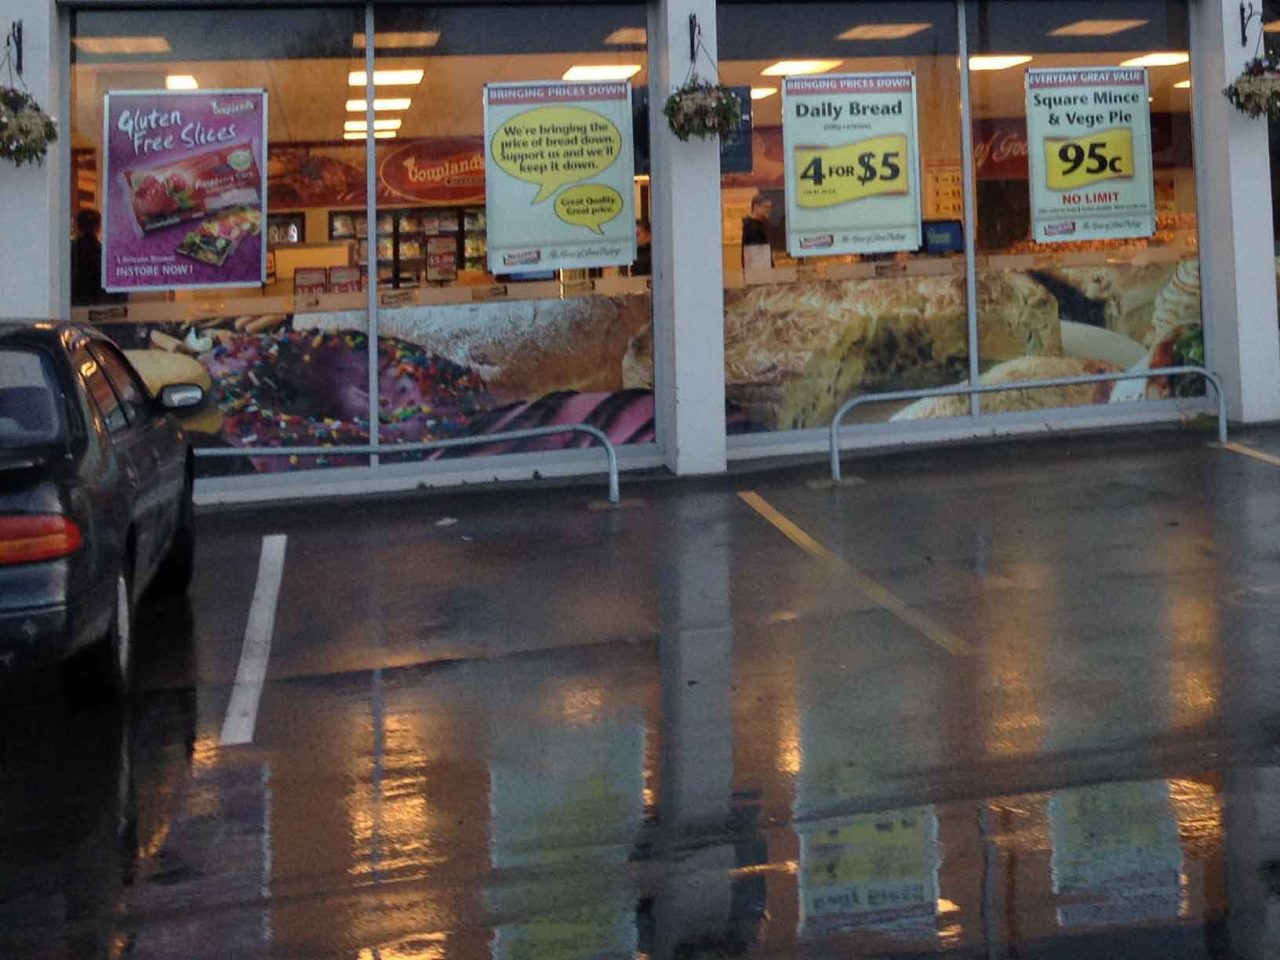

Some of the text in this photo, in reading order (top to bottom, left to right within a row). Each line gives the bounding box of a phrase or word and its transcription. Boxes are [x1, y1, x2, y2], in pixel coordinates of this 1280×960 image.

[787, 77, 910, 90] BRINGING PRICES DOWN
[1029, 71, 1140, 84] EVERYDAY GREAT VALUE
[490, 85, 626, 99] BRINGING PRICES DOWN
[1034, 91, 1139, 109] Square Mince
[796, 100, 902, 120] Daily Bread
[118, 109, 181, 138] Gluten
[1048, 110, 1132, 128] & Vege Pie
[503, 122, 608, 136] We're bringing the
[134, 121, 237, 156] Free Slices
[501, 139, 529, 150] price
[531, 137, 542, 147] of
[546, 136, 578, 146] bread
[548, 150, 560, 159] us
[563, 147, 584, 157] and
[587, 146, 613, 156] we'll
[992, 133, 1028, 161] Goo
[520, 160, 598, 174] keep it down.
[1058, 142, 1123, 176] 95c
[800, 151, 901, 187] 4 FOR $5
[1062, 192, 1120, 205] NO LIMIT
